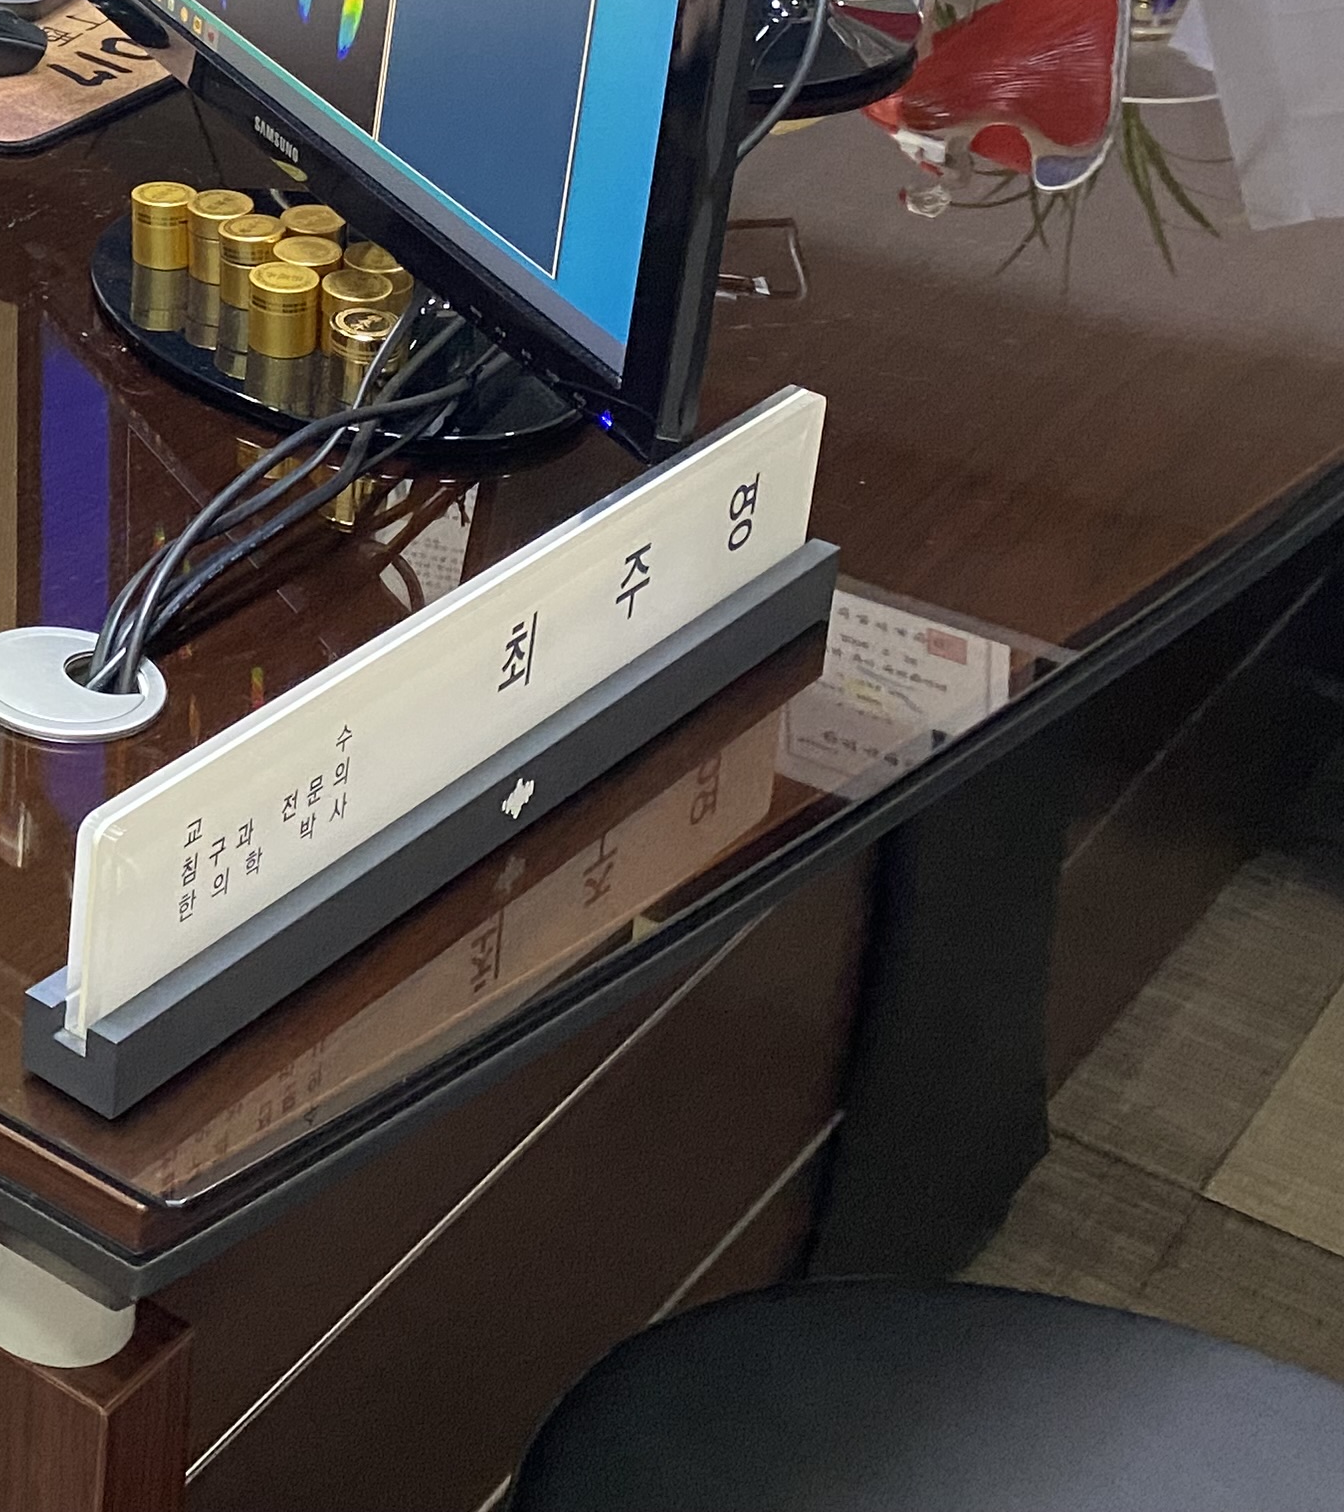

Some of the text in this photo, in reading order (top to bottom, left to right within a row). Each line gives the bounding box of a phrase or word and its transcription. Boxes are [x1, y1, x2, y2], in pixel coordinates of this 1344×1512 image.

[254, 115, 299, 163] SAMSUNG
[498, 472, 761, 692] 최 주 영
[184, 724, 353, 848] 교 수
